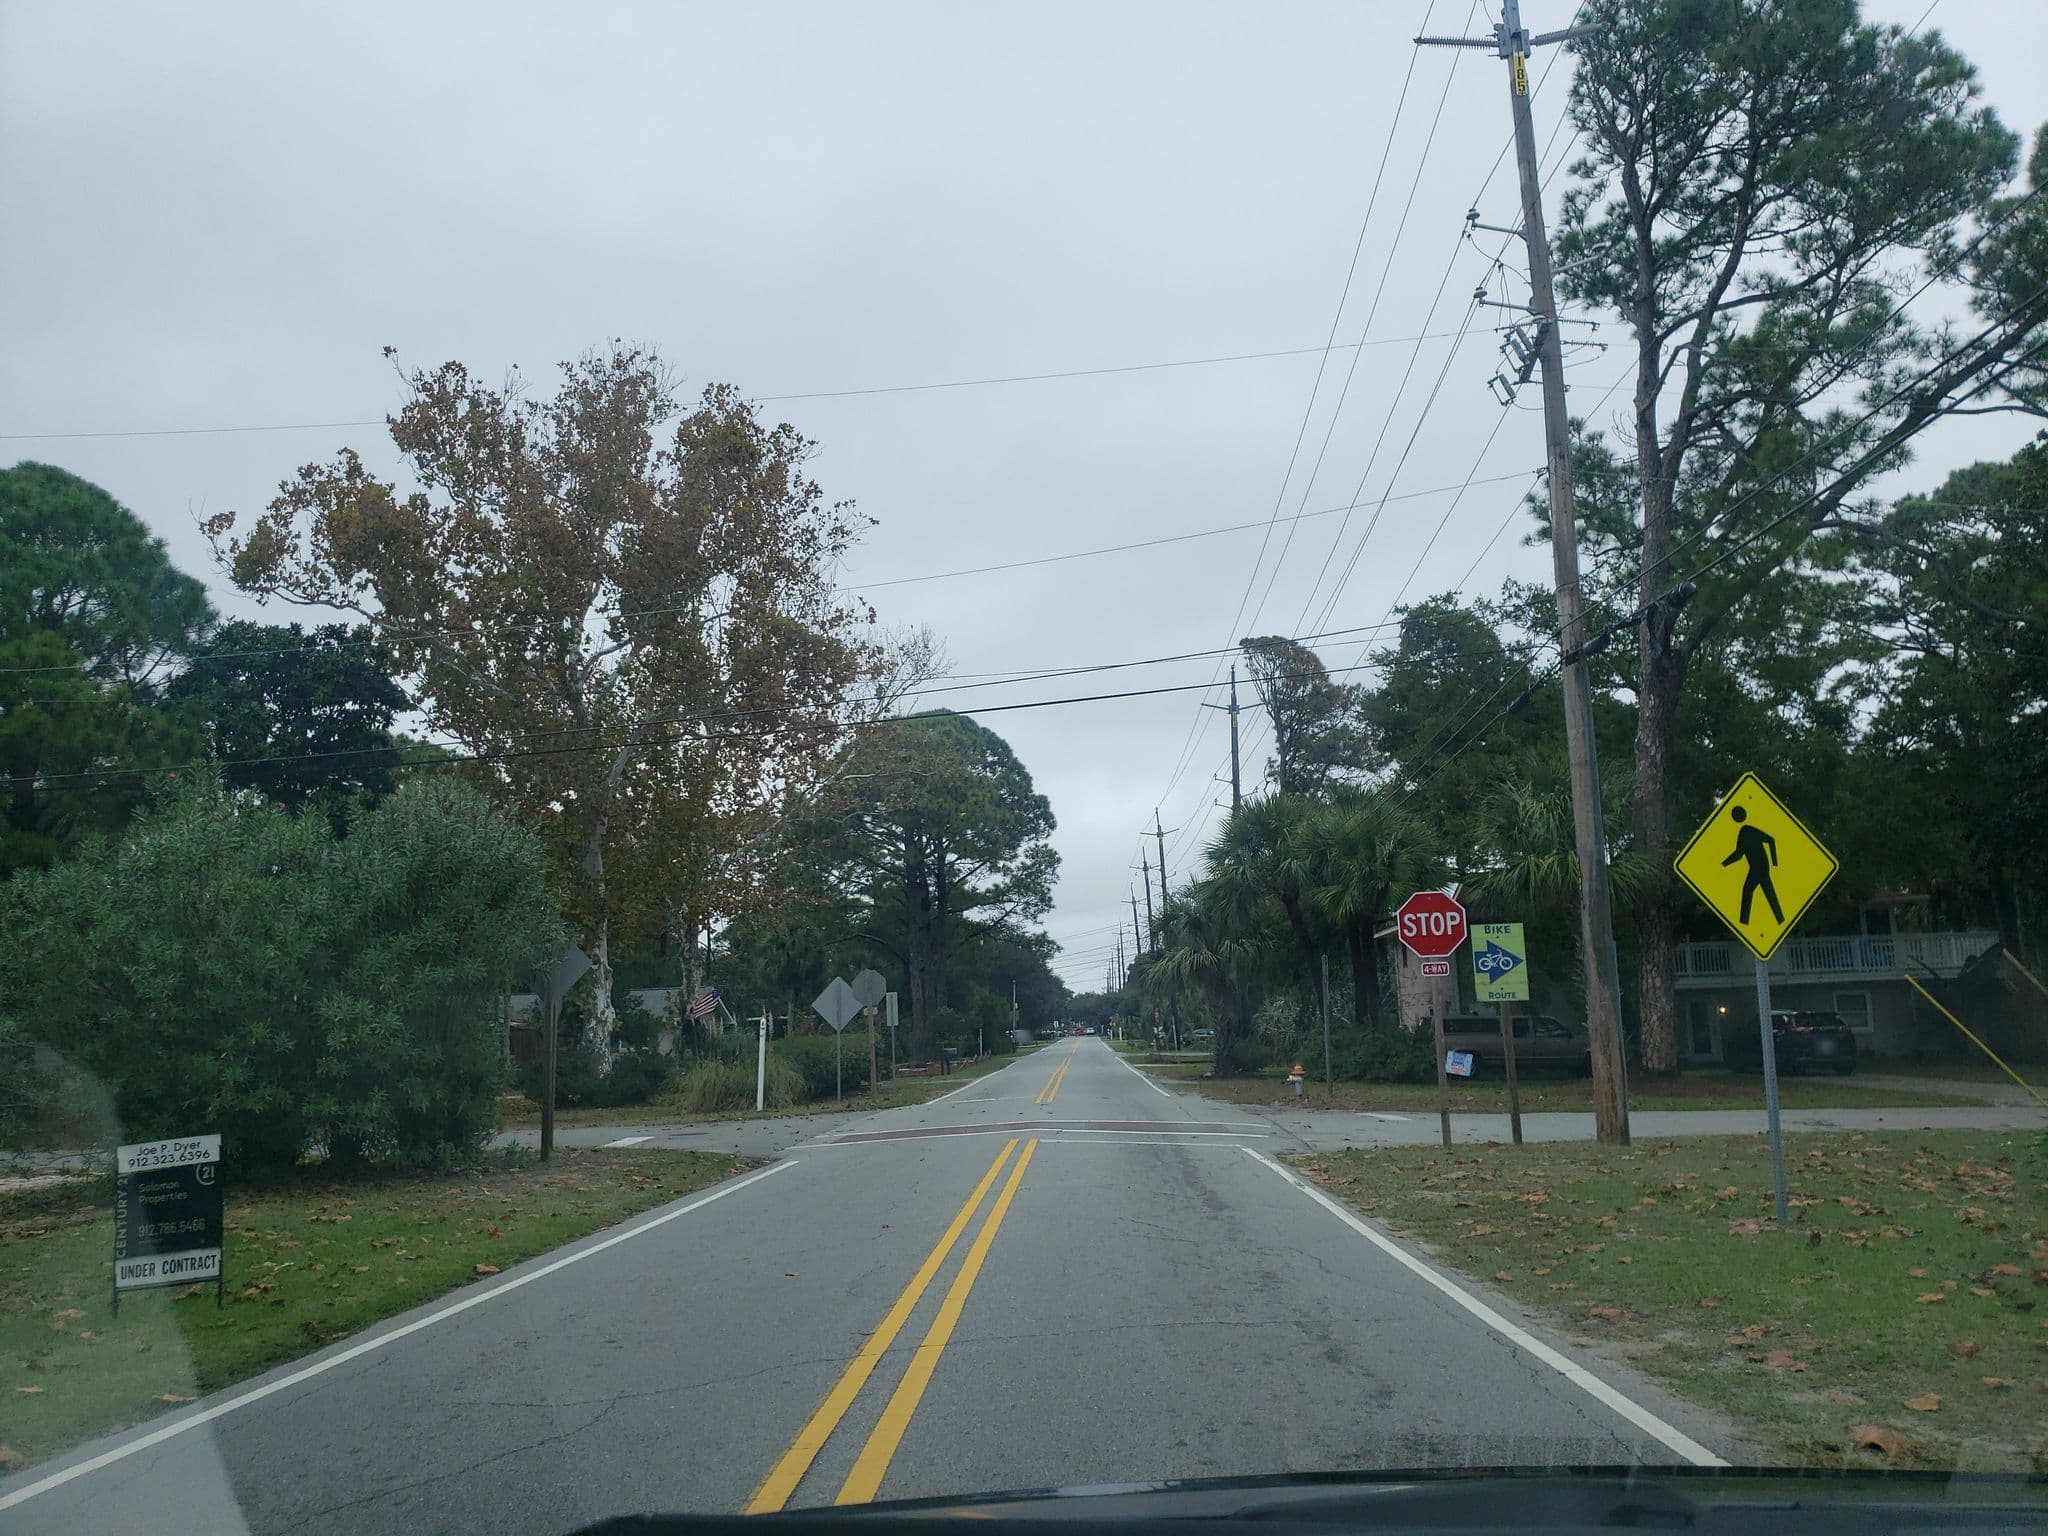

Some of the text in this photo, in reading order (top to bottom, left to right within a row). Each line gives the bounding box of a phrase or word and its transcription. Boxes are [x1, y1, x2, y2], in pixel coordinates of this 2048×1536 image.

[1516, 56, 1526, 92] 185
[1403, 911, 1461, 937] STOP
[1484, 924, 1512, 934] BIKE
[1423, 963, 1449, 976] 4-WAY
[1488, 991, 1517, 1000] ROUTE
[137, 1140, 201, 1157] Joe P. Dyer
[128, 1149, 211, 1169] 912.323.6396
[139, 1191, 189, 1205] Properties
[117, 1191, 128, 1258] CENTURY
[120, 1254, 217, 1280] UNDER CONTRACT
